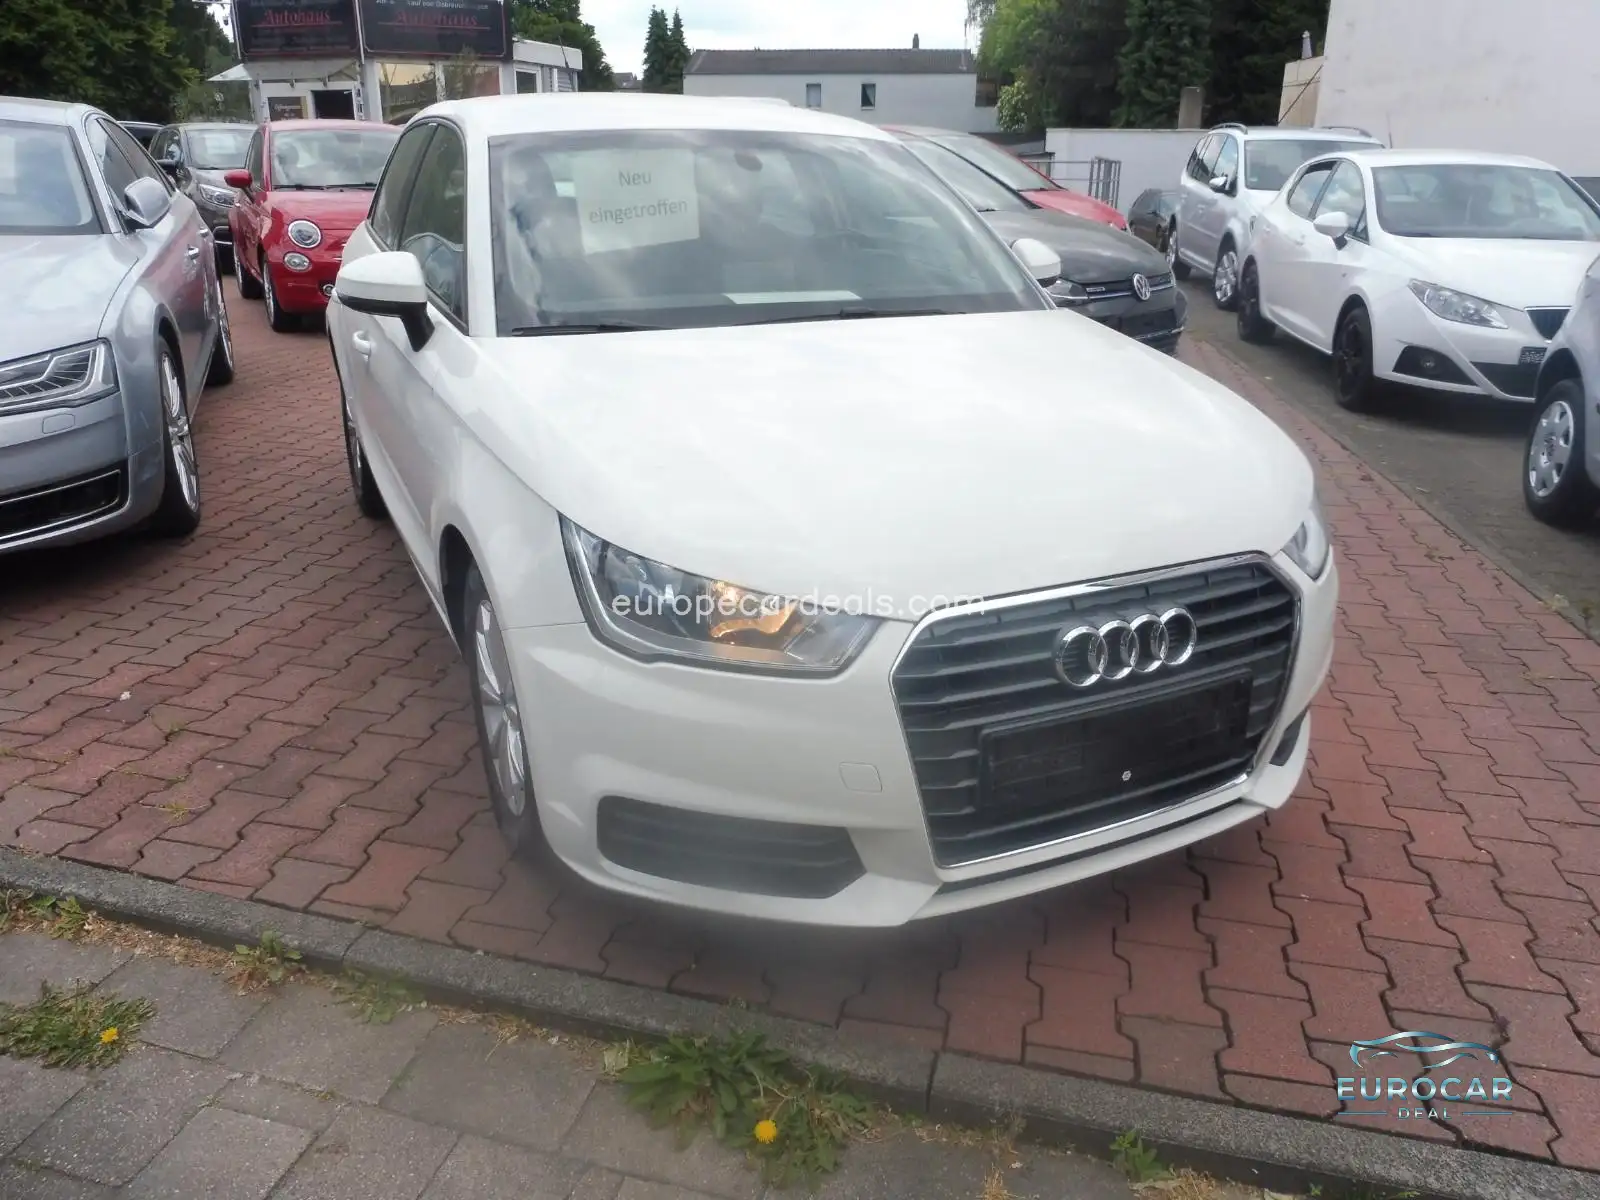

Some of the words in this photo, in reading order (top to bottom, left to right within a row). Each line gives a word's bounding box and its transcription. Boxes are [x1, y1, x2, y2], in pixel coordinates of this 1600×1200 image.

[265, 9, 331, 24] Autohaus
[618, 170, 652, 187] Neu
[589, 198, 689, 224] eingetroffen
